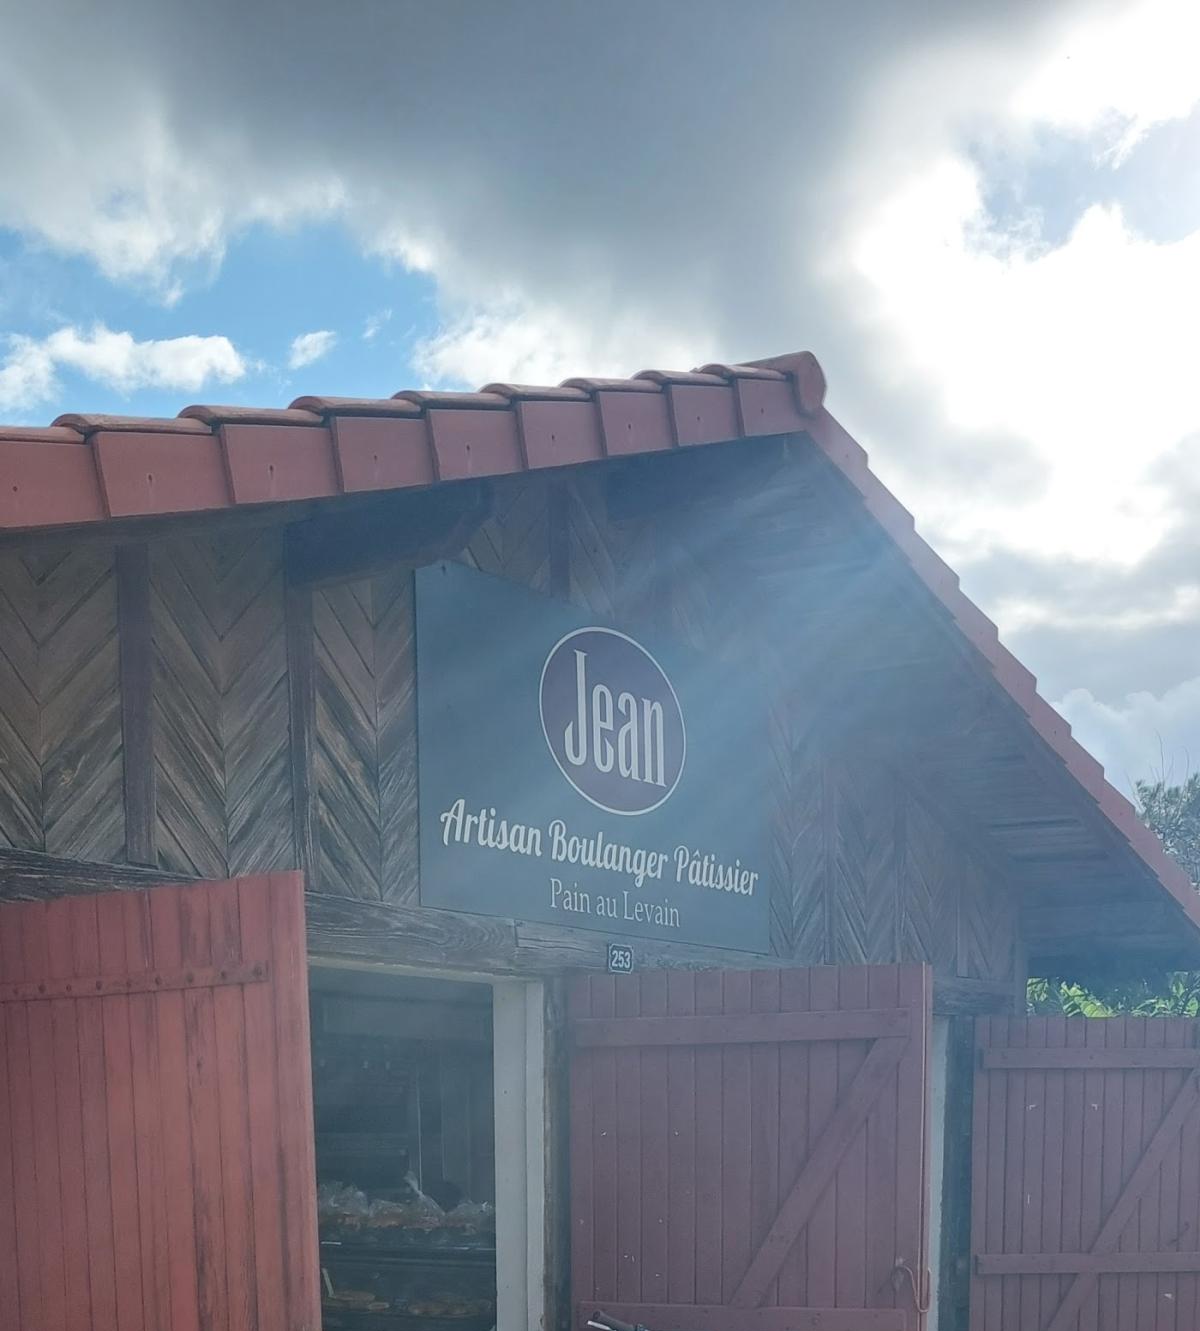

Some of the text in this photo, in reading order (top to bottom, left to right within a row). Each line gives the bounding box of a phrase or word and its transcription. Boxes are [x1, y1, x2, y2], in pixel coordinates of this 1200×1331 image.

[564, 649, 667, 787] Jean
[440, 798, 759, 896] Artisan Boulanger Pâtissier
[550, 878, 680, 927] Pain au Levain
[611, 950, 631, 969] 253
